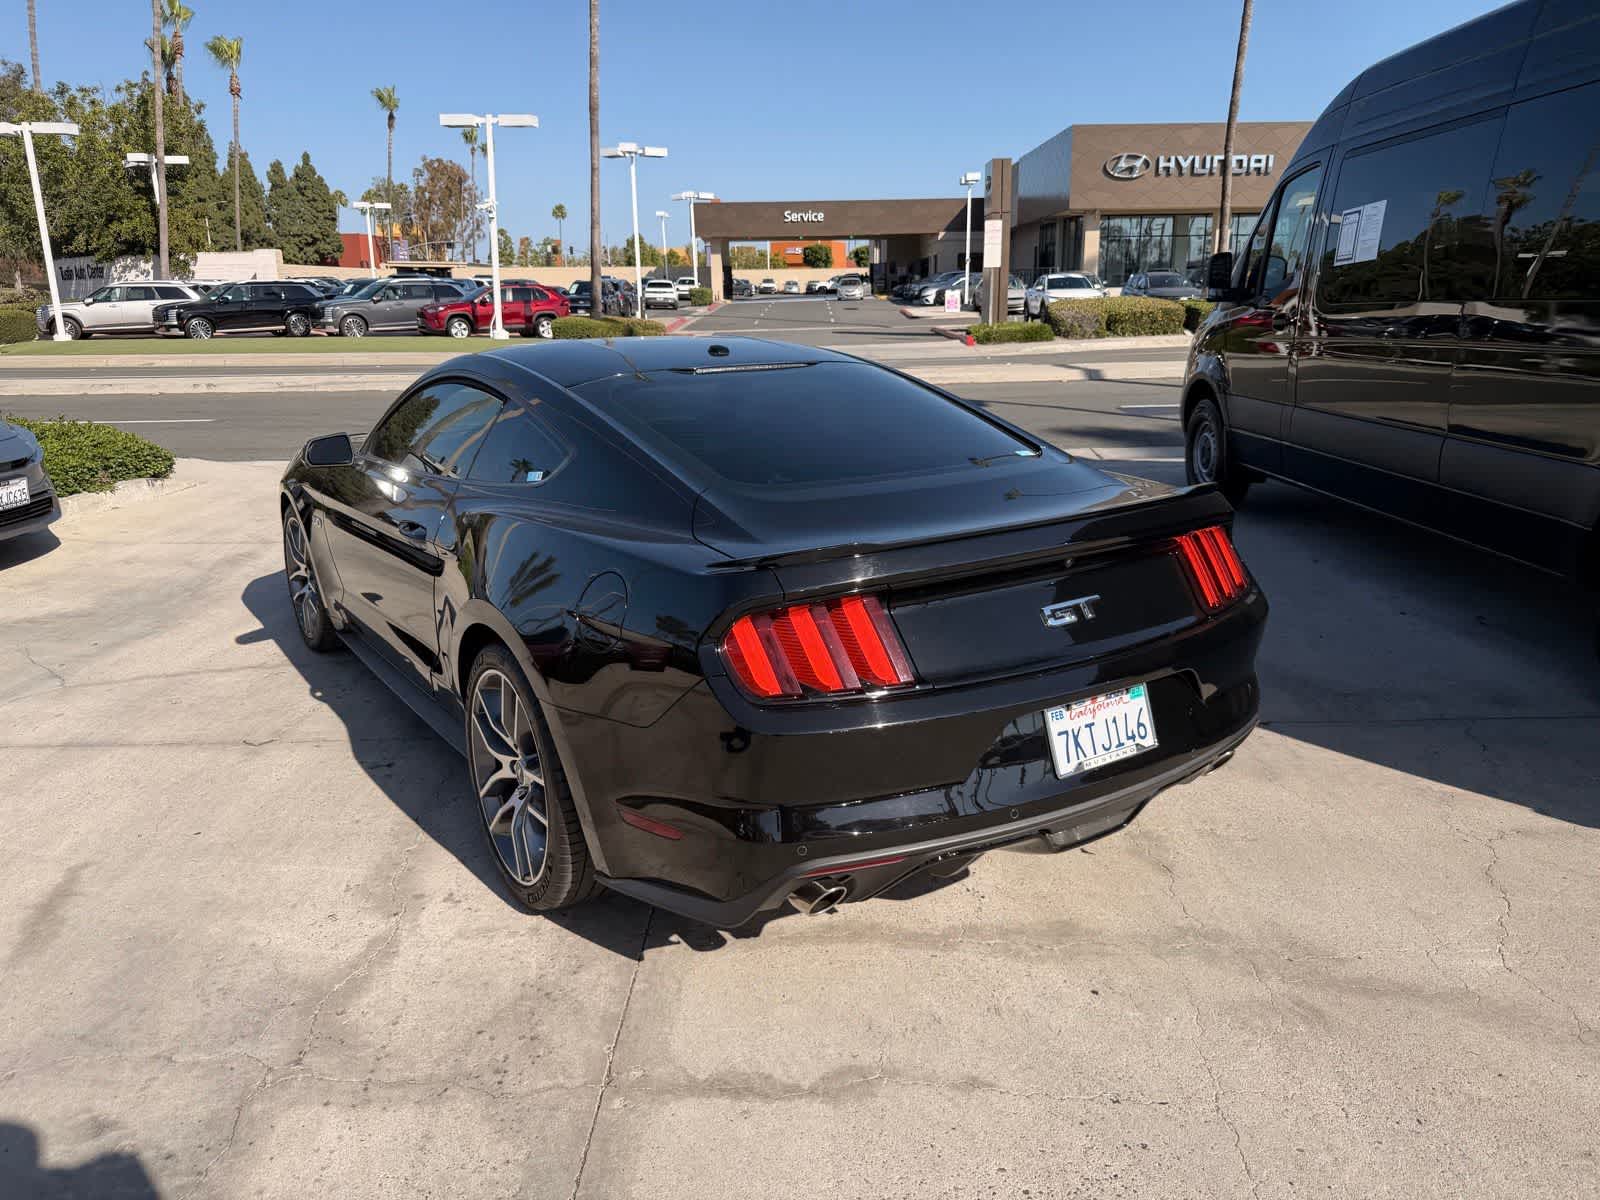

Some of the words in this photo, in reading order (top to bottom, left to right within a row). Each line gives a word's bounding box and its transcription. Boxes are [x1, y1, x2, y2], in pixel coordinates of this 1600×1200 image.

[784, 210, 825, 222] Service
[1040, 594, 1101, 628] GT
[1050, 709, 1065, 721] FEB
[1069, 695, 1130, 721] California
[1057, 707, 1148, 764] 7KTJ146
